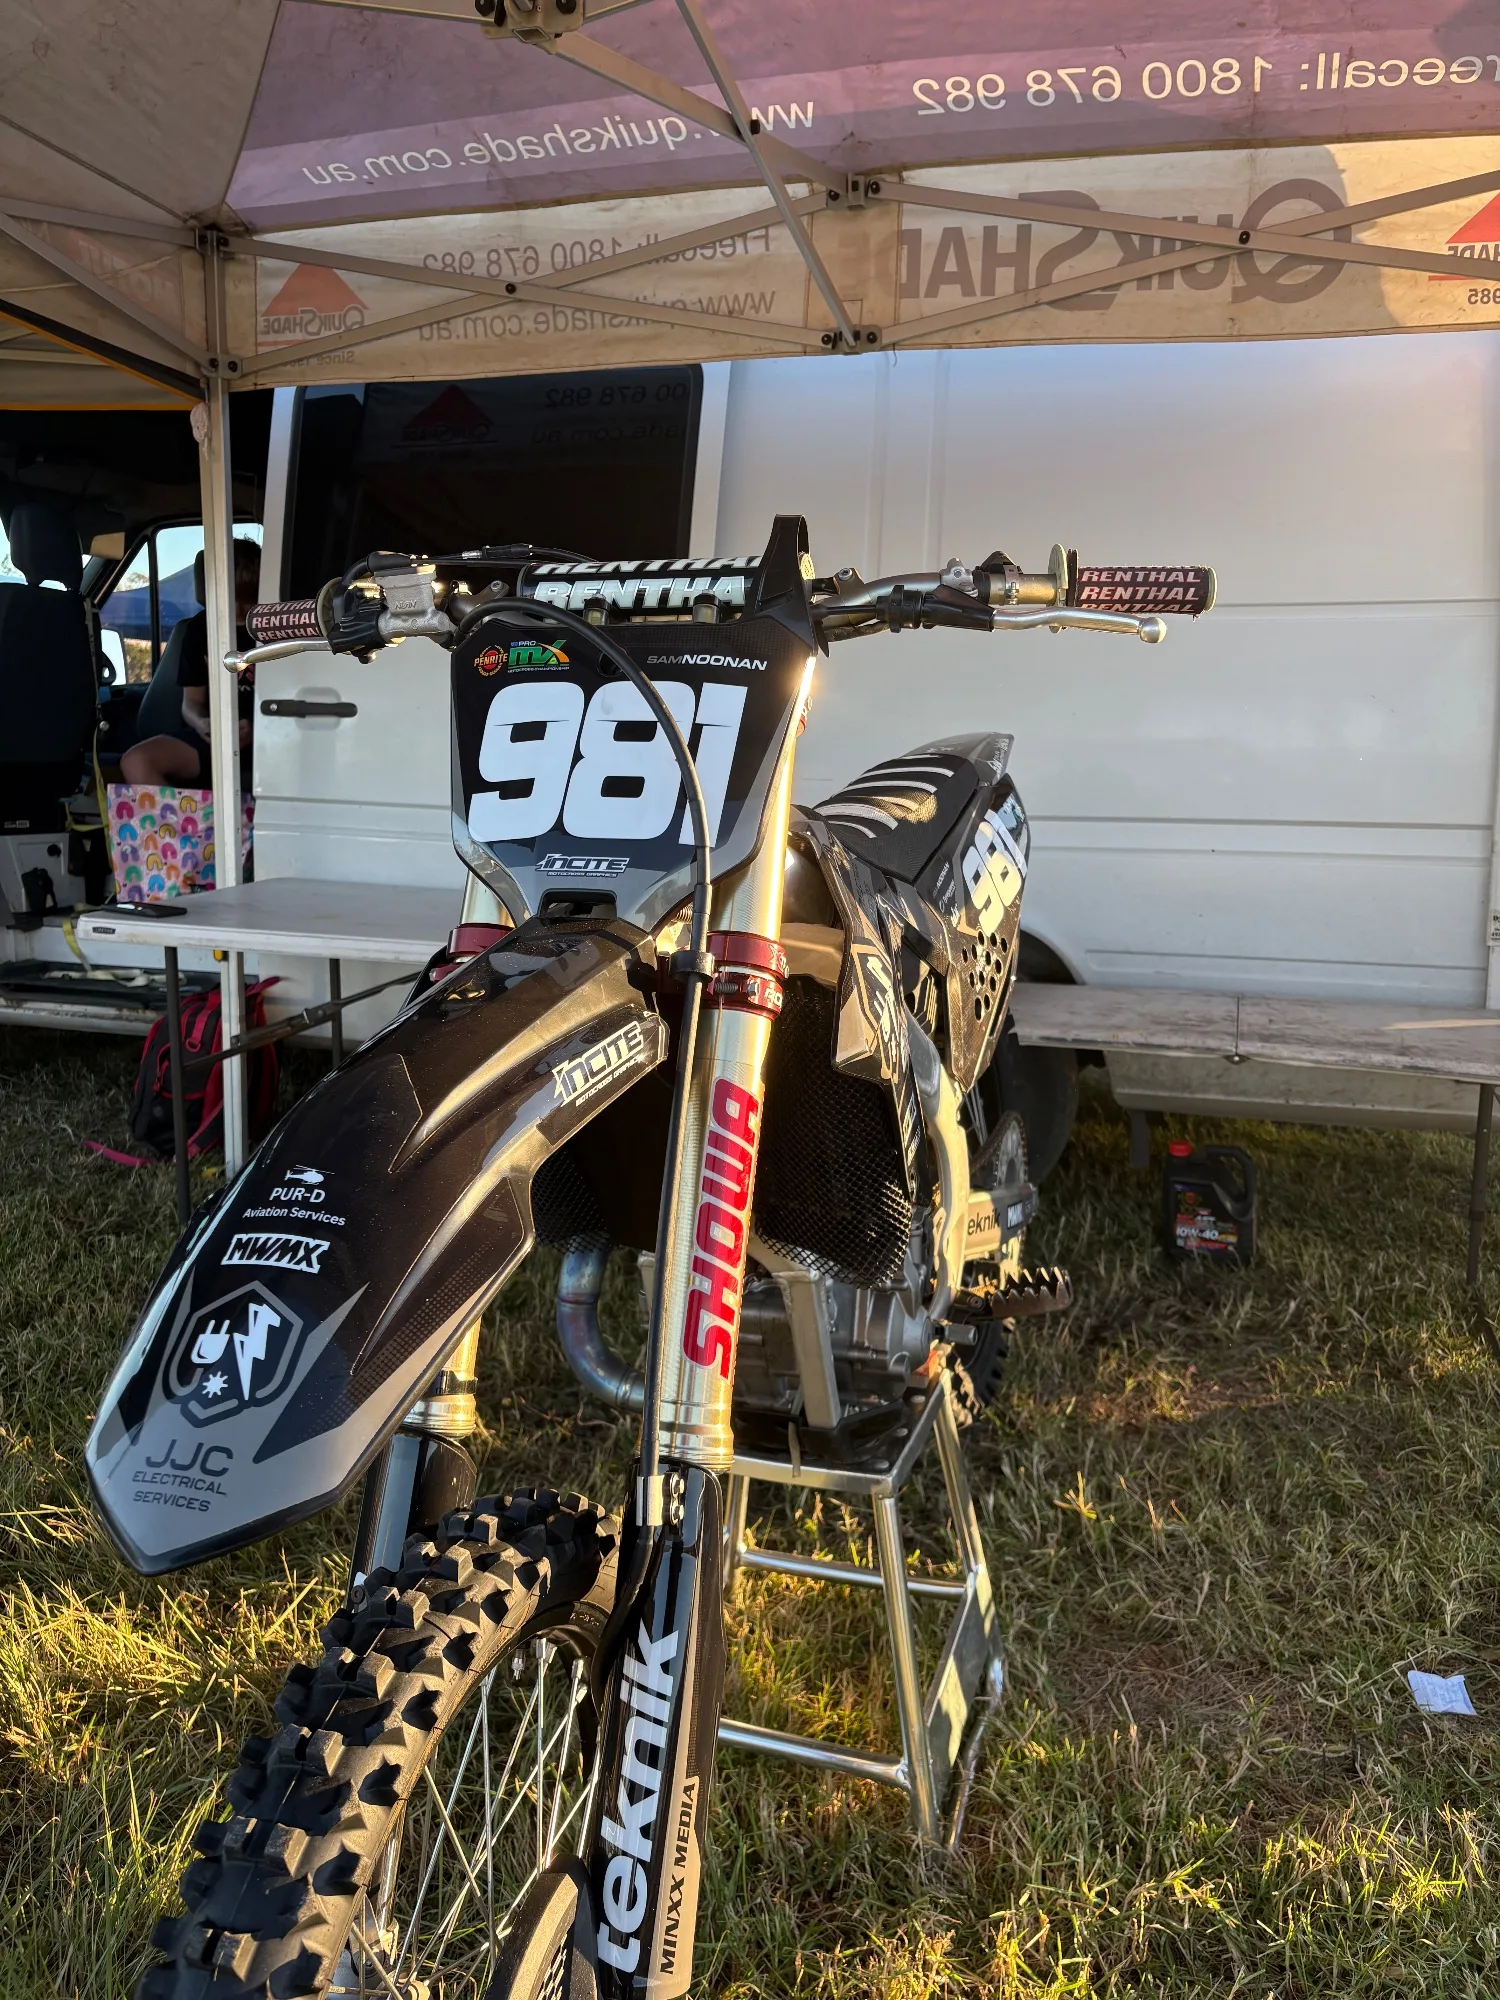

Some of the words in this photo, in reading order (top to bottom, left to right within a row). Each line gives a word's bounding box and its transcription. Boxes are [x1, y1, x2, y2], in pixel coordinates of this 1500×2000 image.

[1081, 570, 1201, 583] RENTHAL
[534, 576, 750, 610] RENTHA
[1079, 586, 1200, 601] RENTHAL
[474, 653, 509, 667] PENRITE
[467, 680, 748, 848] 981
[552, 1021, 644, 1107] INCITE
[269, 1187, 326, 1203] PUR-D
[242, 1206, 288, 1219] Aviation
[289, 1207, 346, 1226] Services
[683, 1077, 762, 1382] SHOWA
[967, 1208, 1001, 1236] eknik
[221, 1233, 331, 1274] MWMX
[145, 1438, 234, 1478] JJC
[132, 1470, 227, 1498] ELECTRICAL
[133, 1490, 211, 1513] SERVICES
[596, 1617, 680, 1974] teknik
[660, 1872, 686, 1976] MINXX
[674, 1783, 697, 1870] MEDIA
